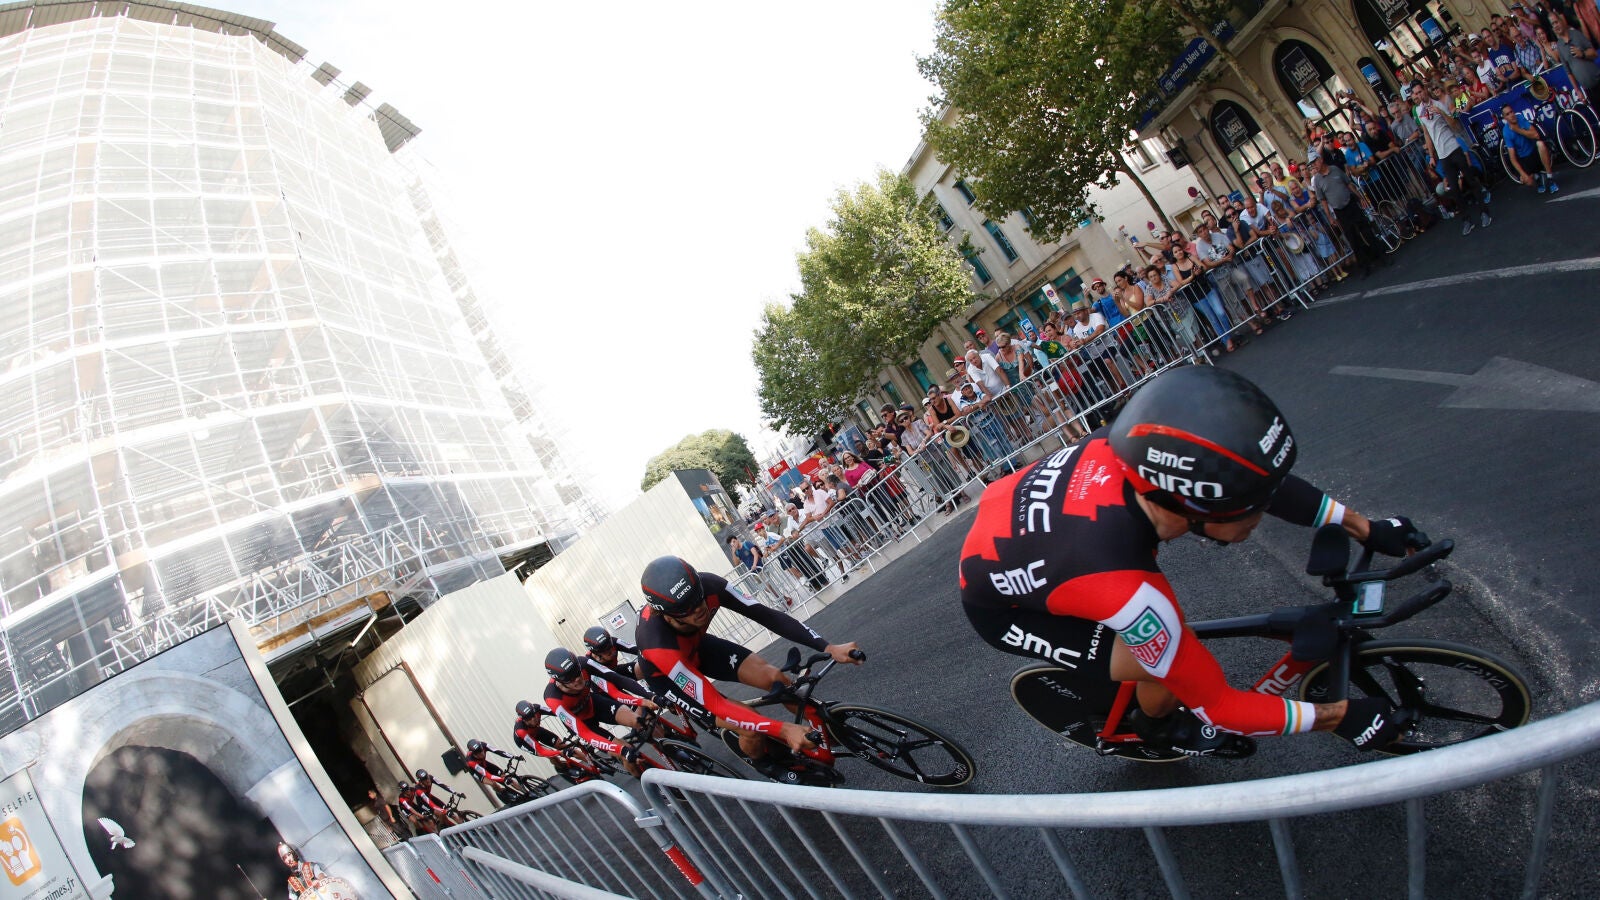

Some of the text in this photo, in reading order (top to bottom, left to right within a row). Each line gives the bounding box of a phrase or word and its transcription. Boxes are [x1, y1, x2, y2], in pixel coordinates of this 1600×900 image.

[1291, 61, 1312, 81] bleu
[1223, 121, 1241, 138] bleu
[1258, 416, 1284, 455] BMC
[1147, 447, 1196, 471] BMC
[1272, 434, 1294, 468] GIRO
[1028, 445, 1080, 533] BMC
[1138, 464, 1223, 498] GIRO
[670, 577, 687, 595] BMC
[989, 559, 1047, 595] BMC
[676, 585, 692, 599] GIRO
[1001, 624, 1082, 669] BMC
[1256, 664, 1301, 695] MC
[664, 690, 703, 717] BMC
[725, 717, 771, 733] BMC
[1353, 714, 1385, 747] BMC
[590, 739, 618, 751] BMC
[2, 791, 33, 816] SELFIE
